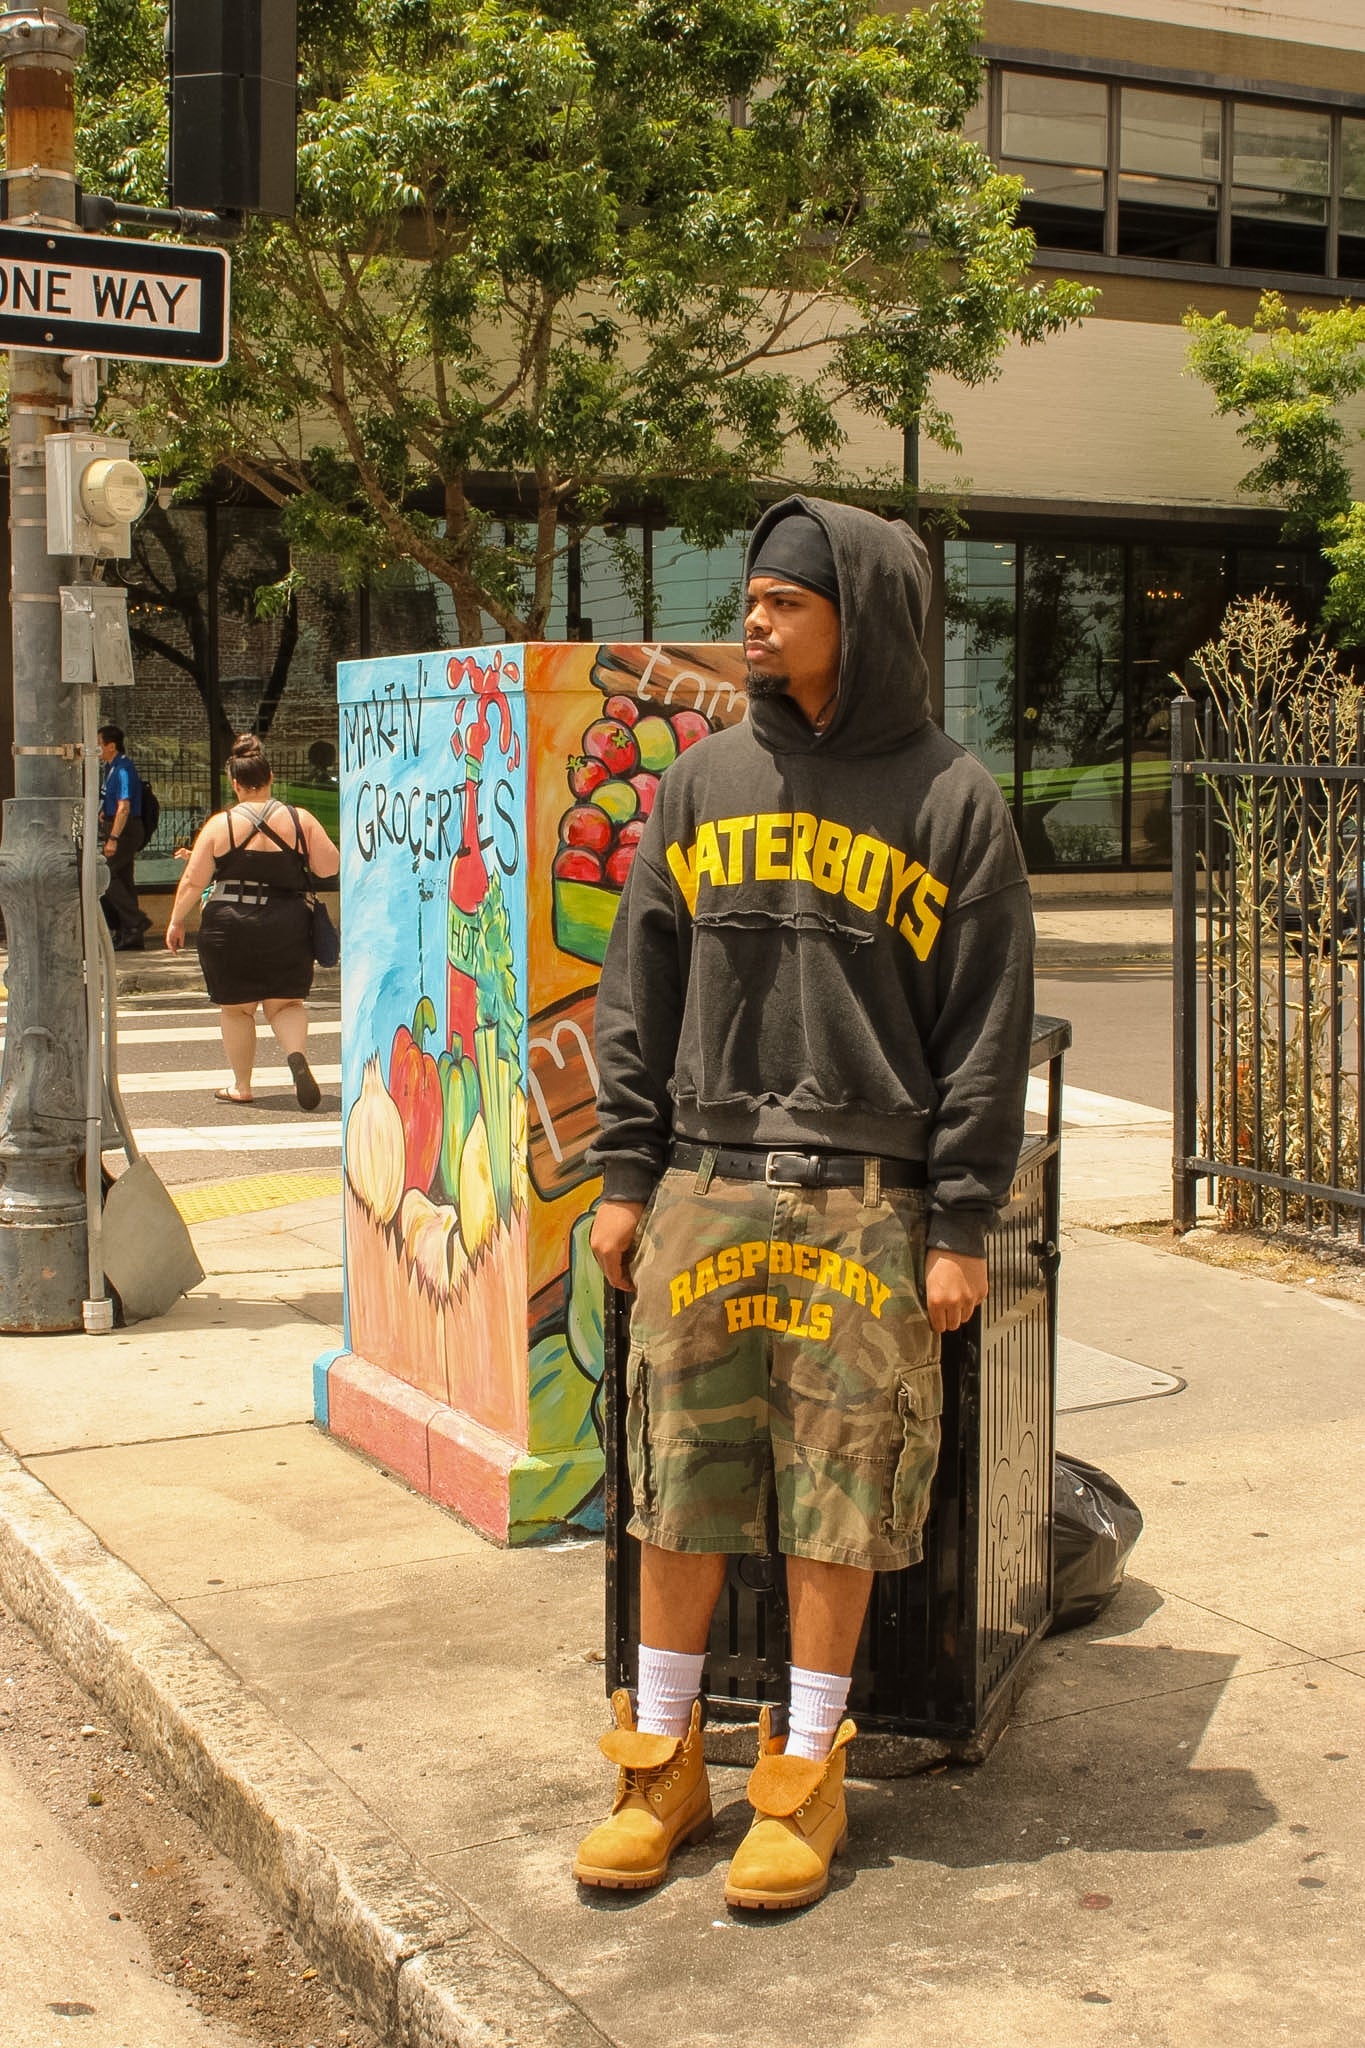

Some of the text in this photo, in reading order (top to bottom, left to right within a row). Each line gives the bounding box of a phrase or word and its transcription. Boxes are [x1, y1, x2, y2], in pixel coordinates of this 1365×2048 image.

[92, 274, 188, 324] WAY
[356, 778, 520, 876] GROCERIES
[451, 914, 480, 964] HOT
[668, 1239, 892, 1319] RASPBERRY
[724, 1294, 834, 1341] HILLS
